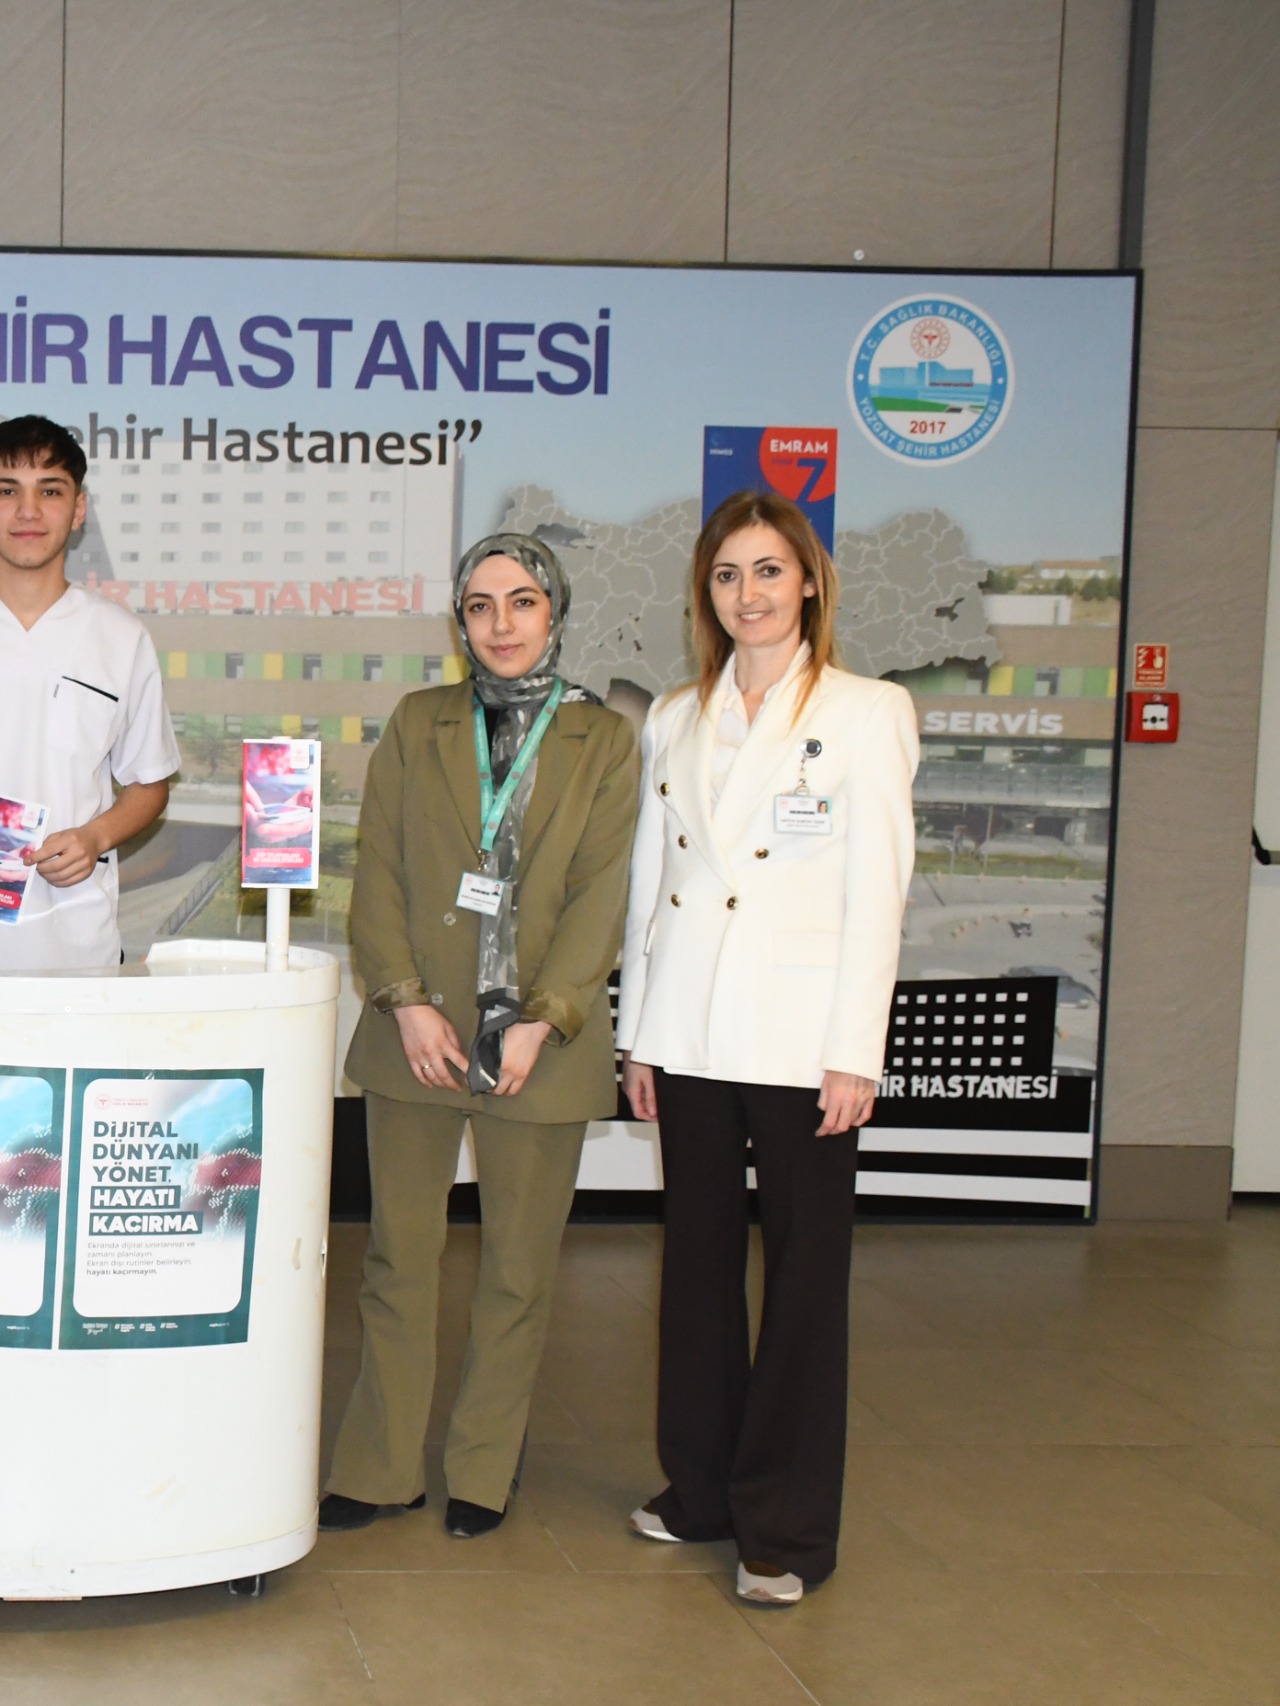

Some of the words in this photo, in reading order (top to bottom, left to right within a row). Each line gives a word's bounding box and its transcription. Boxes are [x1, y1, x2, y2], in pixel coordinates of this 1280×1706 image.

[108, 308, 610, 395] HASTANESİ
[859, 396, 896, 444] YOZGAT
[940, 399, 1001, 456] HASTANESİ
[909, 420, 946, 434] 2017
[769, 439, 829, 454] EMRAM
[795, 457, 828, 503] 7
[144, 574, 424, 611] HASTANESİ
[923, 708, 1064, 735] SERVİS
[910, 1069, 1058, 1100] HASTANESİ
[92, 1139, 200, 1160] DÜNYANI
[93, 1161, 172, 1183] YÖNET,
[94, 1188, 175, 1207] HAYATI
[92, 1214, 199, 1234] KAÇIRMA
[86, 1269, 111, 1277] hayatı
